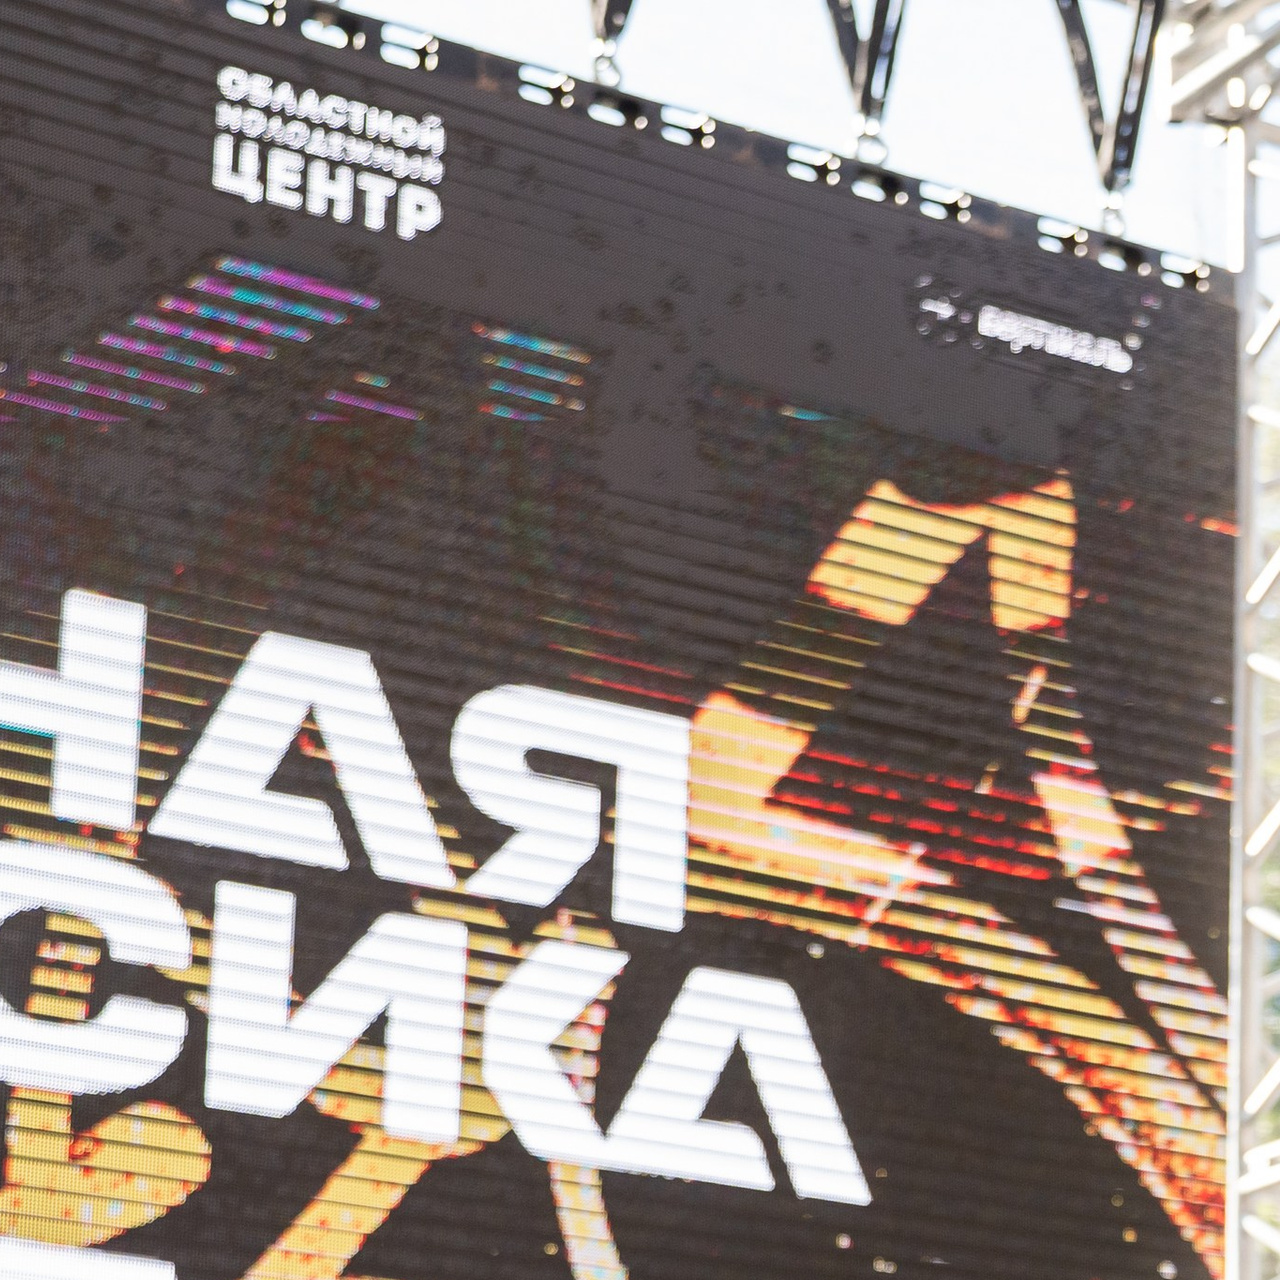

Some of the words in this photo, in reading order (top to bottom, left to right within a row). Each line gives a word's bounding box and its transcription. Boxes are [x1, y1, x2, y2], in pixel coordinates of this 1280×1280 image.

[216, 65, 446, 158] ОБЛАСТНОЙ
[211, 132, 444, 241] ЦЕНТР
[0, 588, 691, 932] НАЯ
